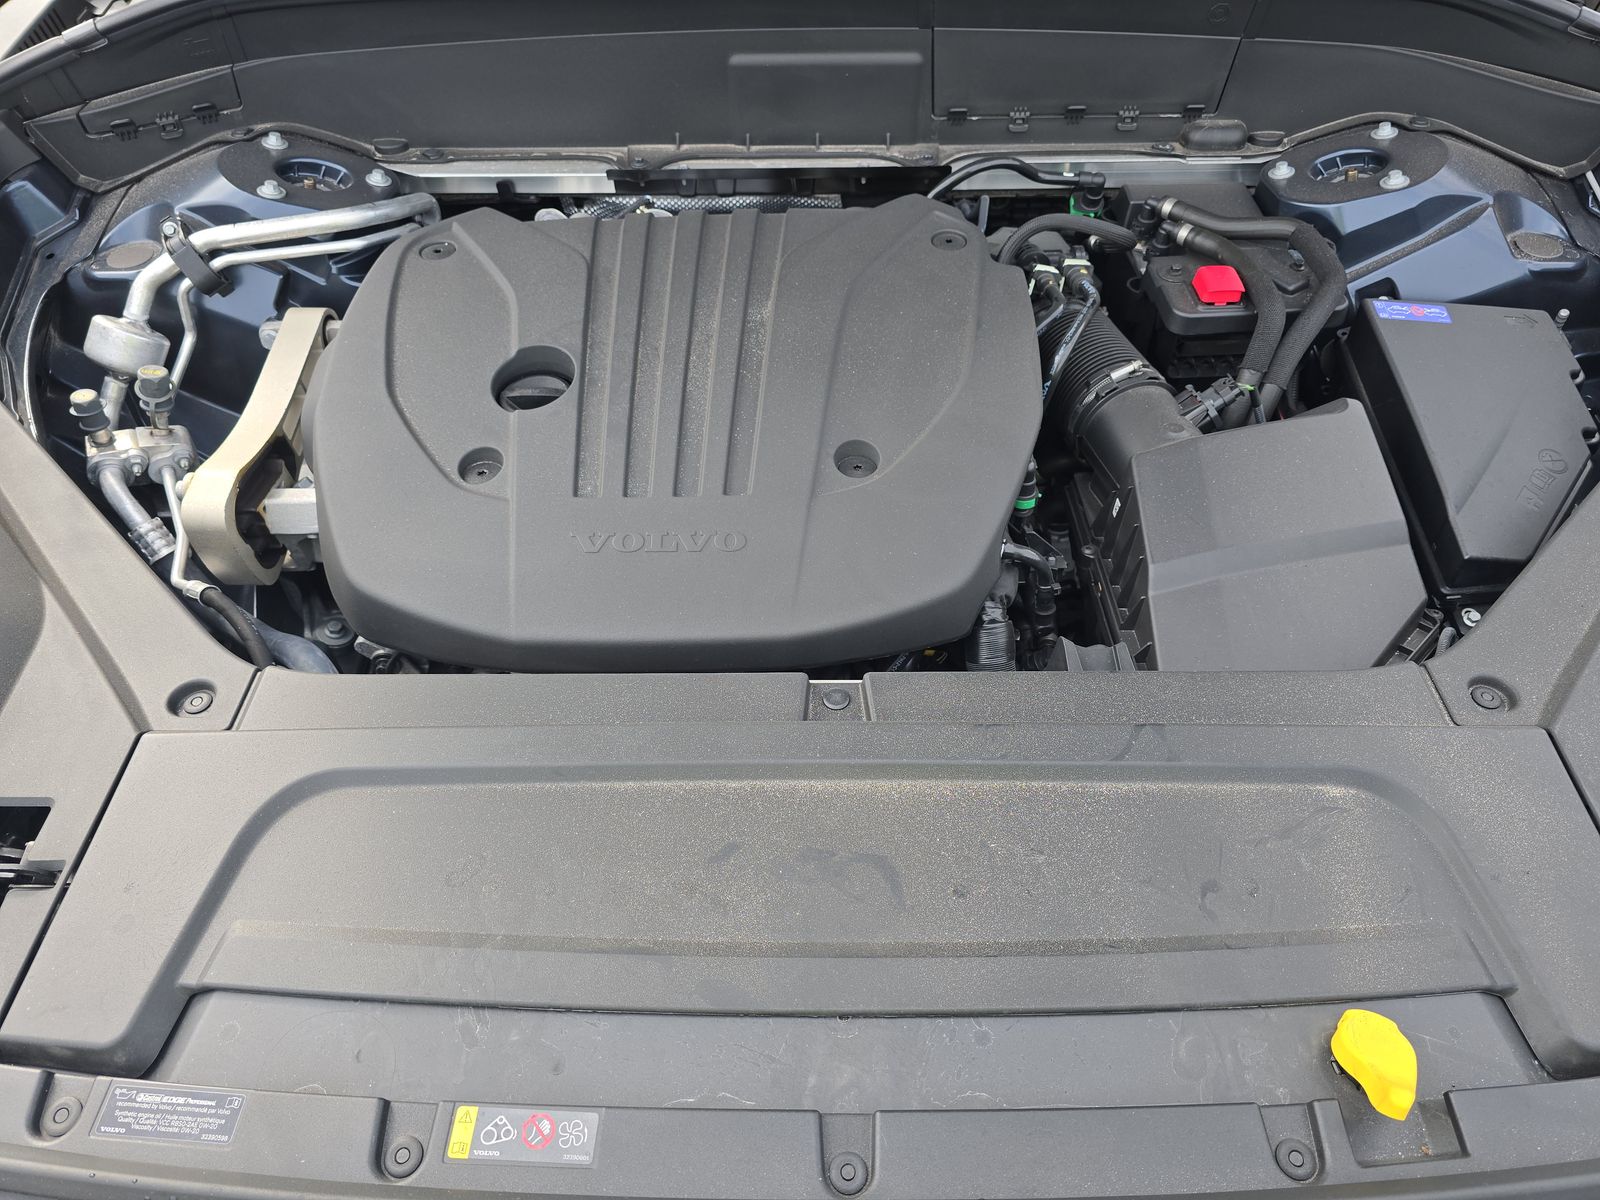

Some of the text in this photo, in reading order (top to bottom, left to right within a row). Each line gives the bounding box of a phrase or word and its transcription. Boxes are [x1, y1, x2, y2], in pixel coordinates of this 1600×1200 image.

[570, 531, 748, 553] VOLVO
[162, 1095, 187, 1104] EDGE
[116, 1101, 151, 1110] recommended
[176, 1105, 208, 1113] recommandé
[207, 1107, 217, 1115] par
[114, 1109, 138, 1118] Synthetic
[118, 1116, 135, 1124] Quality
[131, 1123, 153, 1132] Viscosity
[473, 1149, 500, 1157] VOLVO
